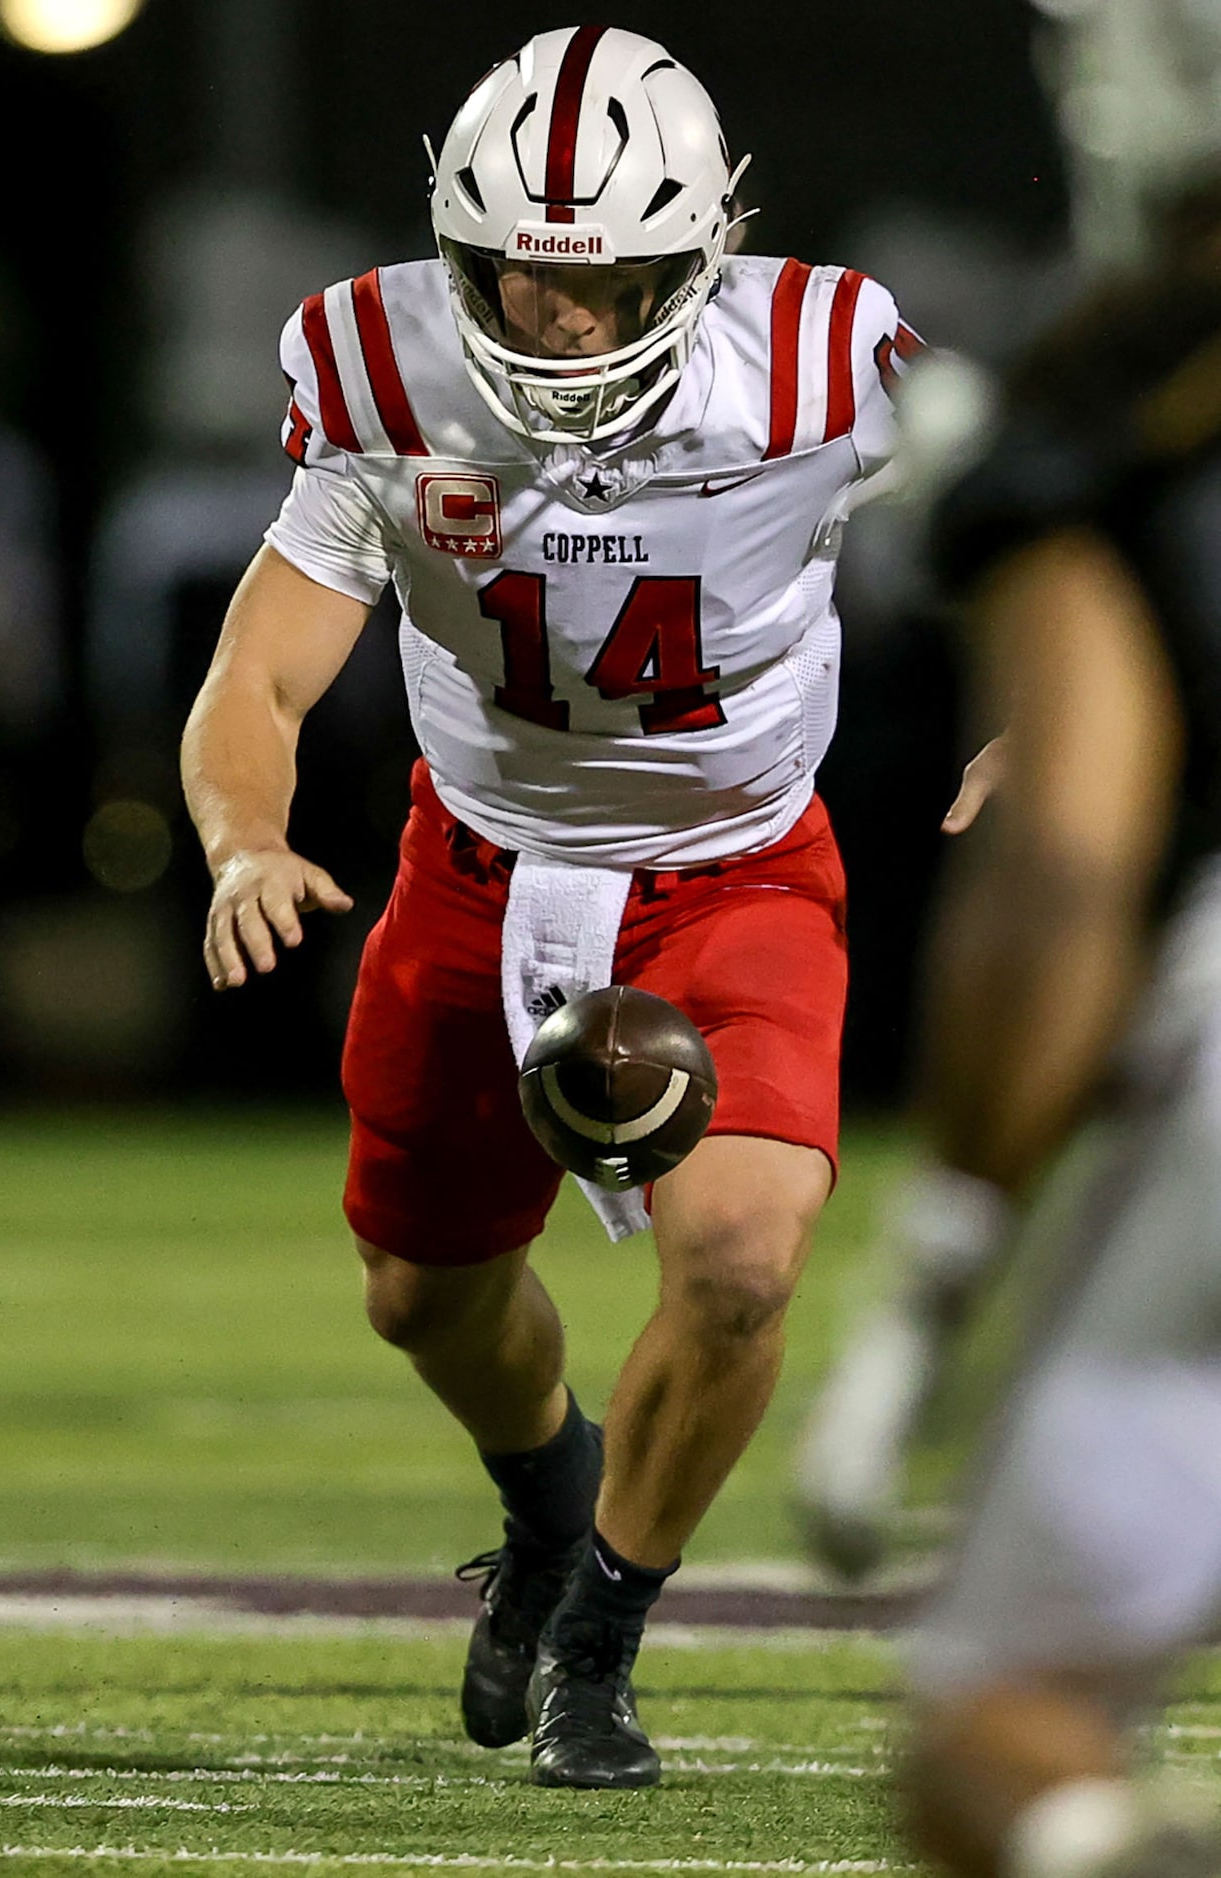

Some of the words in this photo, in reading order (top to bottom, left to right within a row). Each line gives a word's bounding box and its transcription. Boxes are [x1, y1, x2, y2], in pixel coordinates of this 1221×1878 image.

[517, 232, 602, 255] Riddell
[552, 390, 591, 403] Riddell
[425, 478, 495, 537] C
[542, 532, 650, 564] COPPELL
[477, 568, 729, 736] 14
